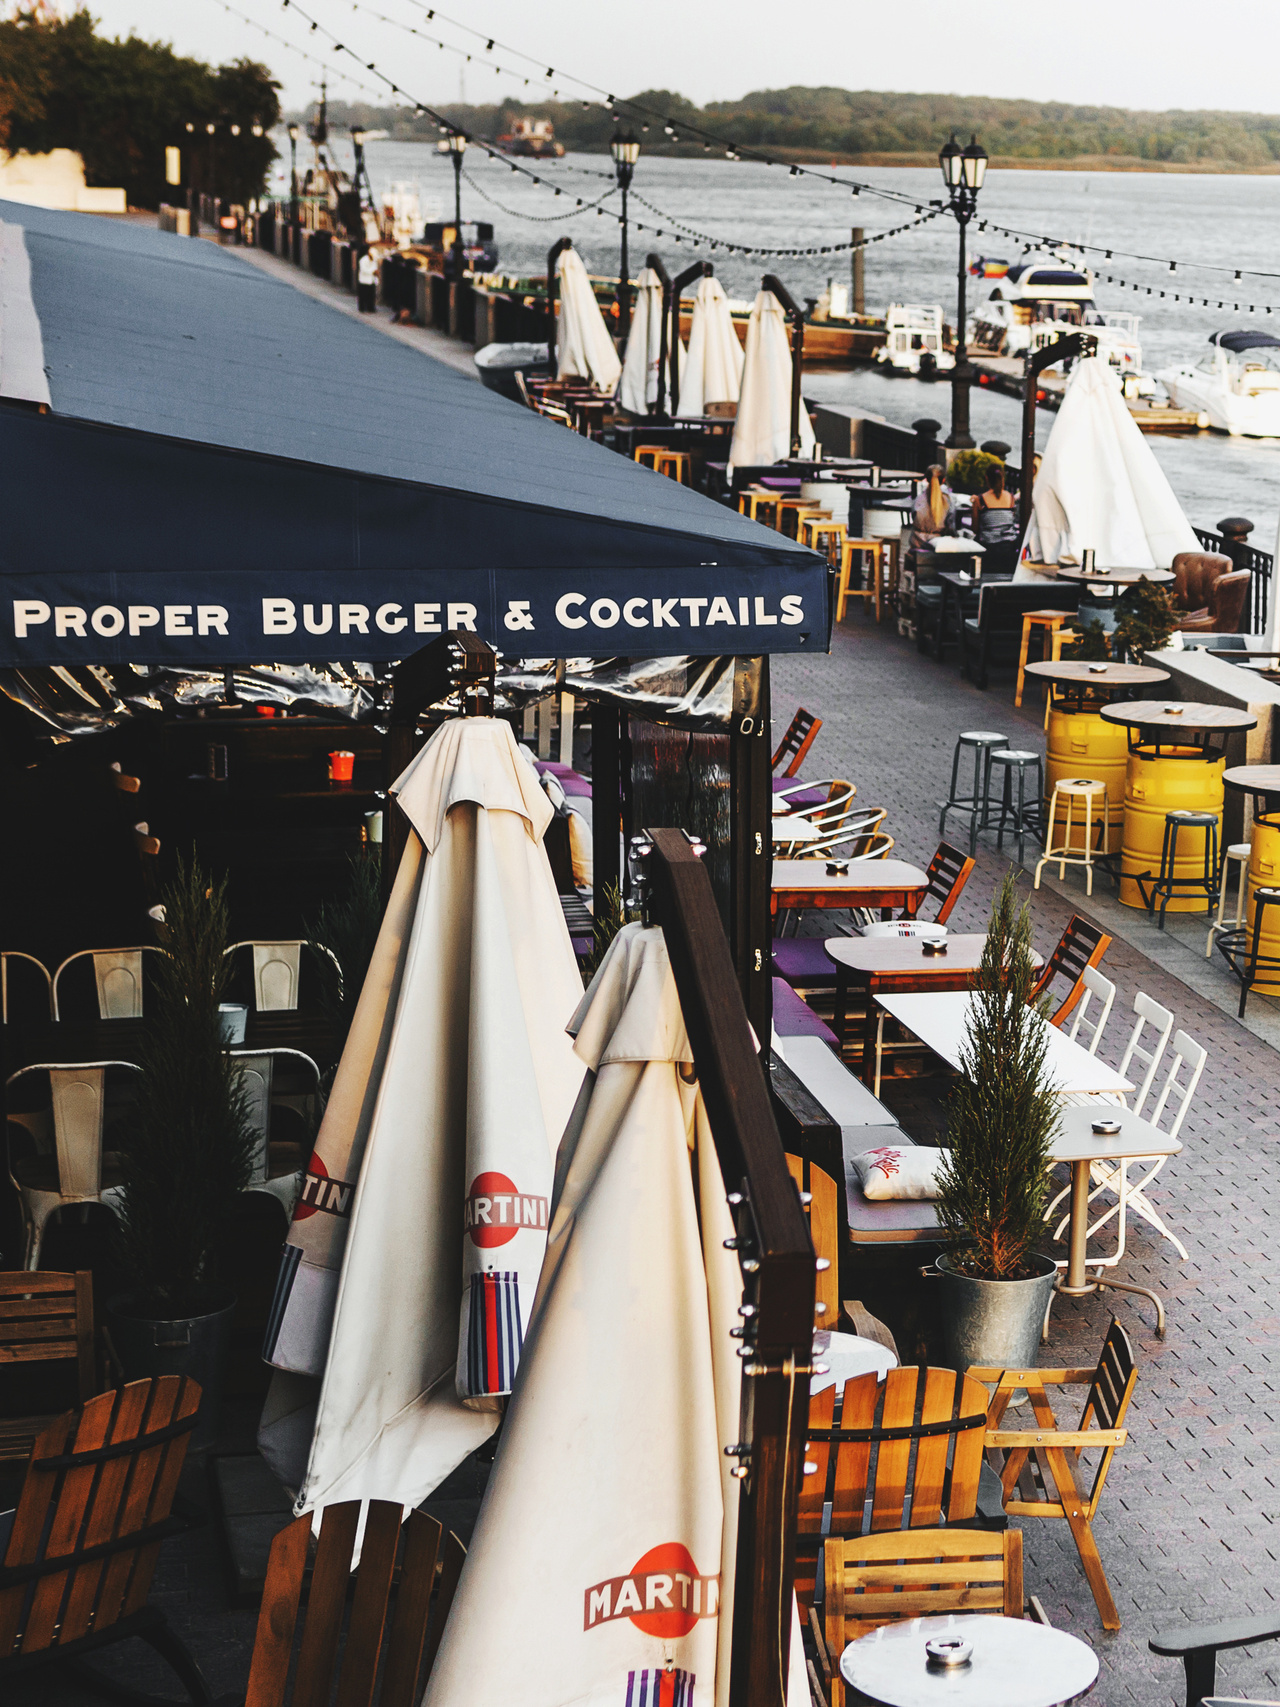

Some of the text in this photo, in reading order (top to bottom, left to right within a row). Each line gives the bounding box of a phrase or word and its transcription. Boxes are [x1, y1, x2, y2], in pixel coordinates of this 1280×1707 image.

[13, 592, 804, 638] PROPER BURGER & COCKTAILS
[464, 1195, 546, 1228] ARTINI
